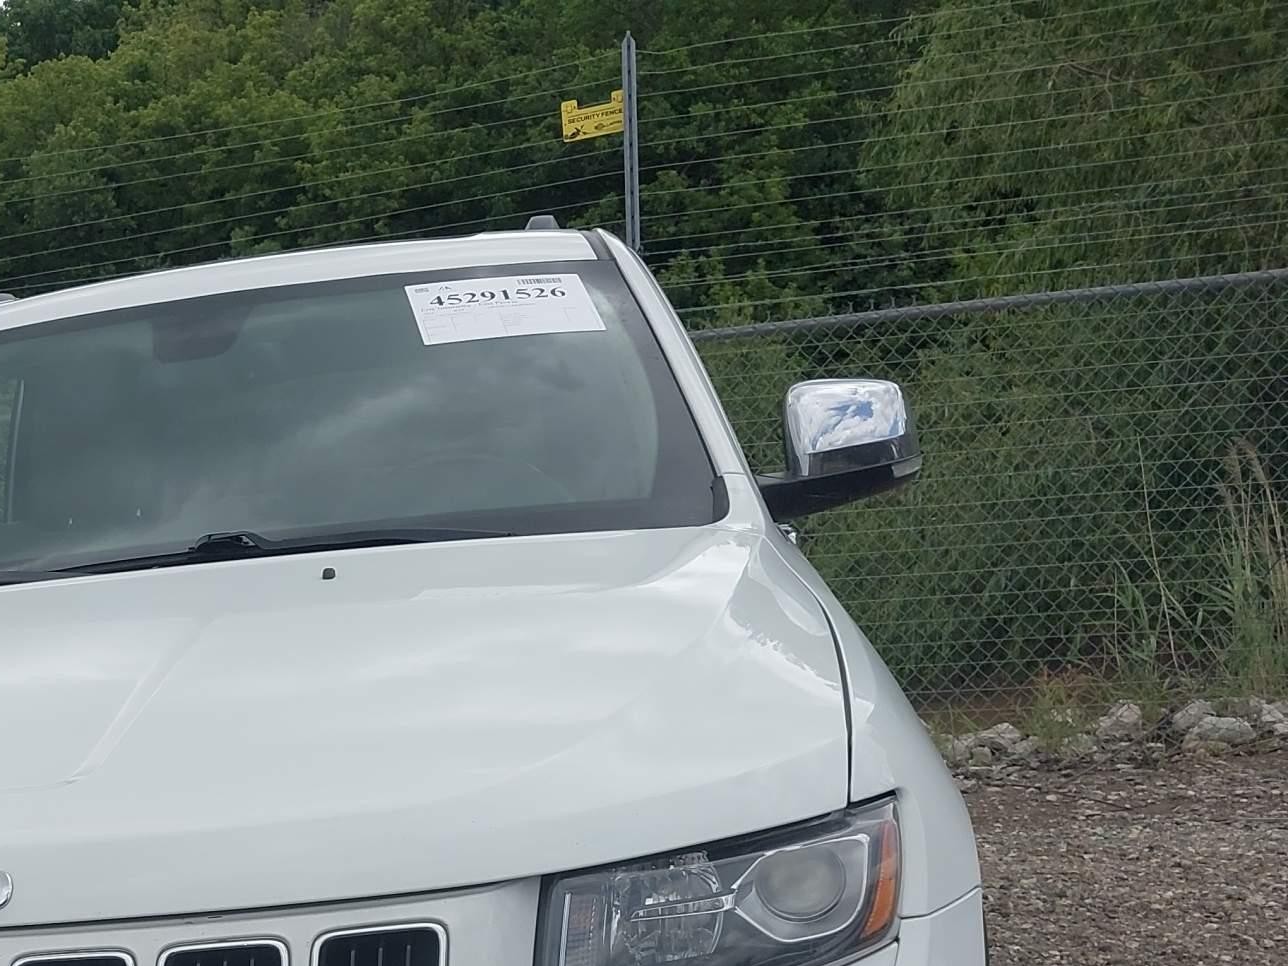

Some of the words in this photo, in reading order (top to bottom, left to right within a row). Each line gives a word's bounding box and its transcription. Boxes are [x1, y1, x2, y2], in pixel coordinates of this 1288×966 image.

[567, 112, 601, 125] SECURITY
[601, 107, 624, 118] FENCE
[429, 286, 567, 307] 45291526
